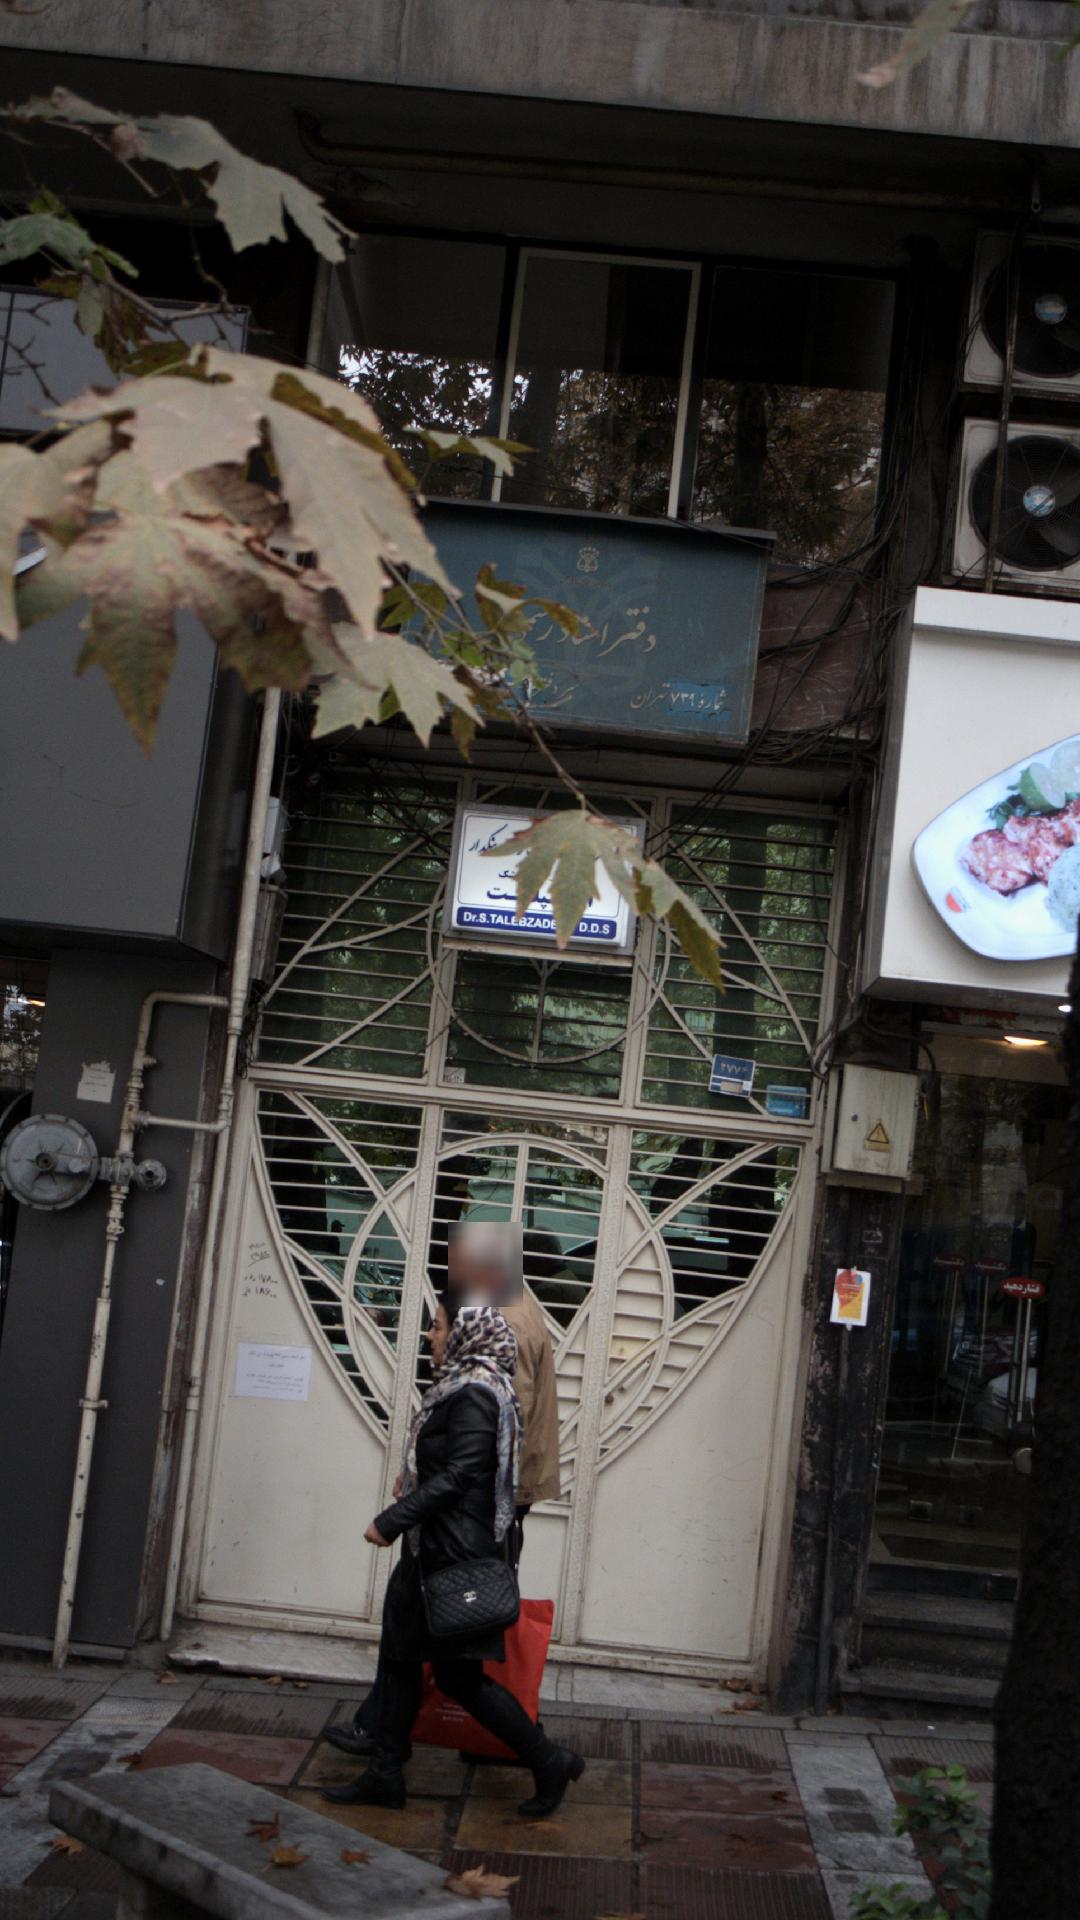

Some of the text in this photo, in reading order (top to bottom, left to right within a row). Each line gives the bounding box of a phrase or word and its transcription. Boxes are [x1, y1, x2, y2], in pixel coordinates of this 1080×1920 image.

[556, 615, 608, 646] اسند
[598, 606, 656, 657] دفتر
[463, 910, 558, 930] Dr.S.TALEBZADE
